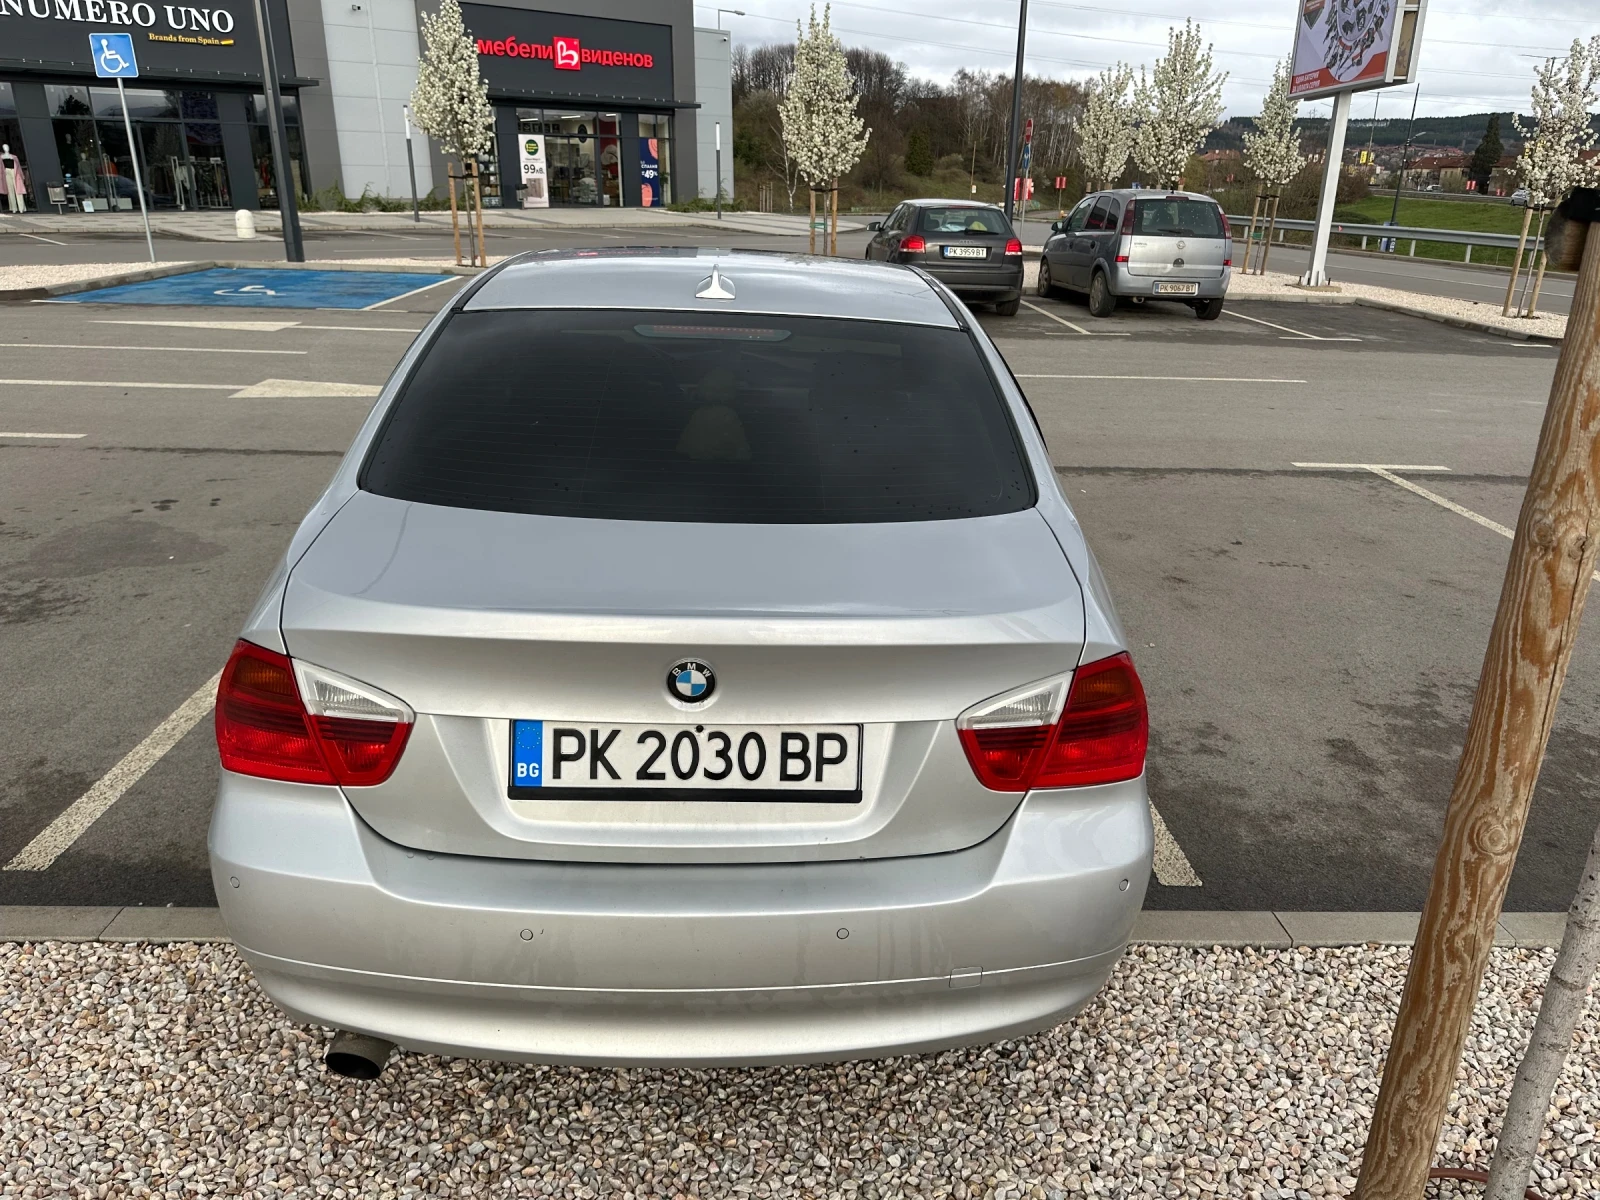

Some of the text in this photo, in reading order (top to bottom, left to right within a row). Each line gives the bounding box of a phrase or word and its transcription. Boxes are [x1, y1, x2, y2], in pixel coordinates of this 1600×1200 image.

[0, 0, 234, 33] NUMERO UNO
[149, 33, 220, 45] Brands from Spain
[477, 36, 553, 60] мебели
[581, 48, 654, 68] виденов
[1160, 284, 1168, 292] PK
[1169, 284, 1185, 292] 9067
[672, 663, 711, 677] BMW
[552, 728, 848, 783] PK 2030 BP
[517, 763, 540, 778] BG
